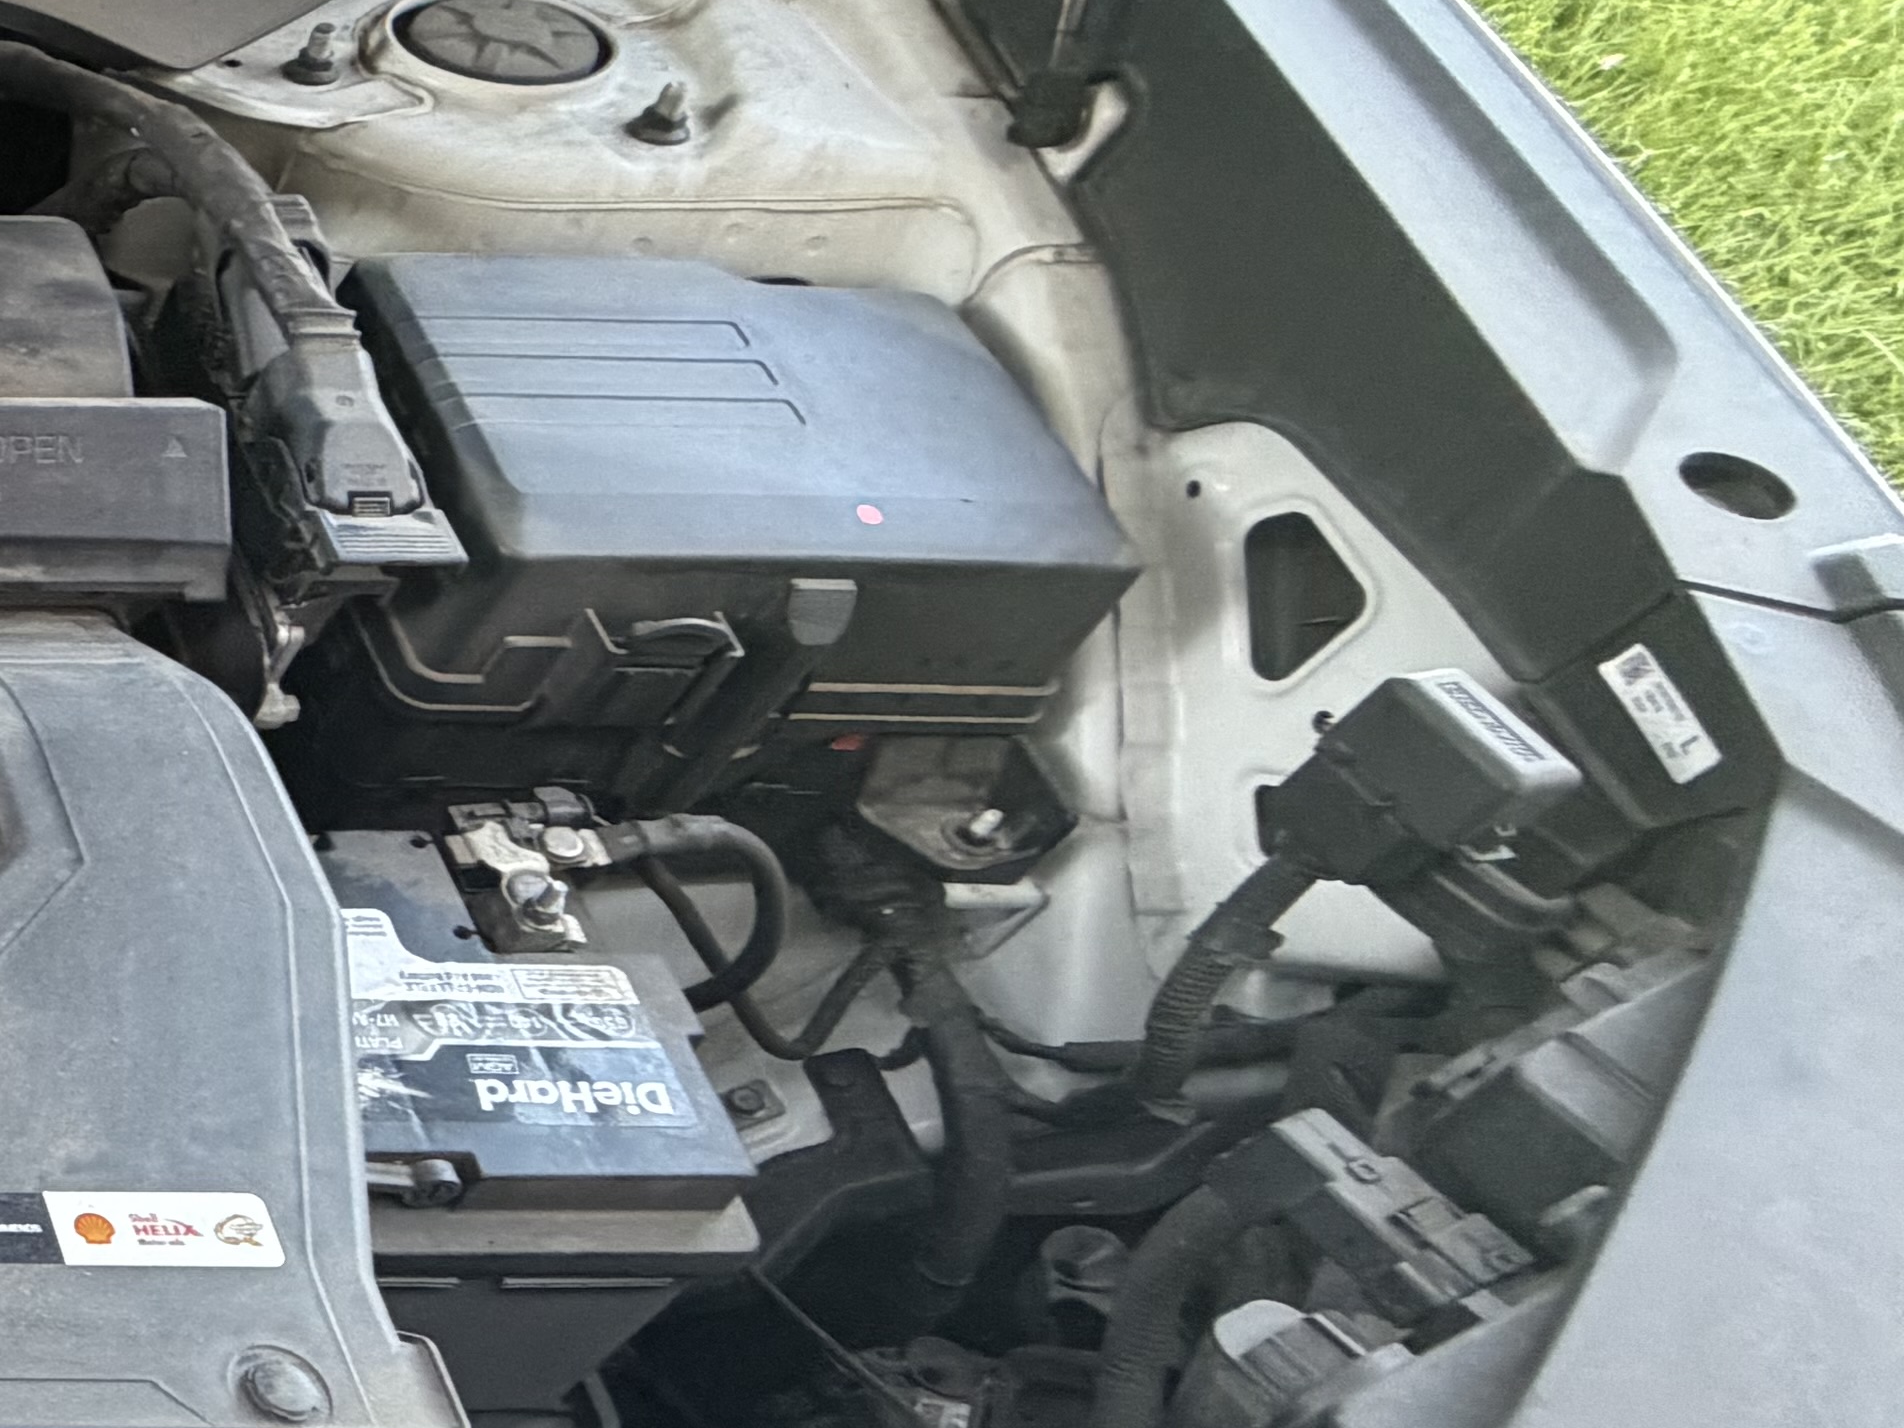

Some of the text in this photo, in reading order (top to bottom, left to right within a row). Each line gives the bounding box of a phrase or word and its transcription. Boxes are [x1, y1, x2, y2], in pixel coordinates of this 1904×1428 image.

[477, 1079, 674, 1115] DieHard
[128, 1213, 159, 1223] Shell
[132, 1222, 203, 1237] HELIX
